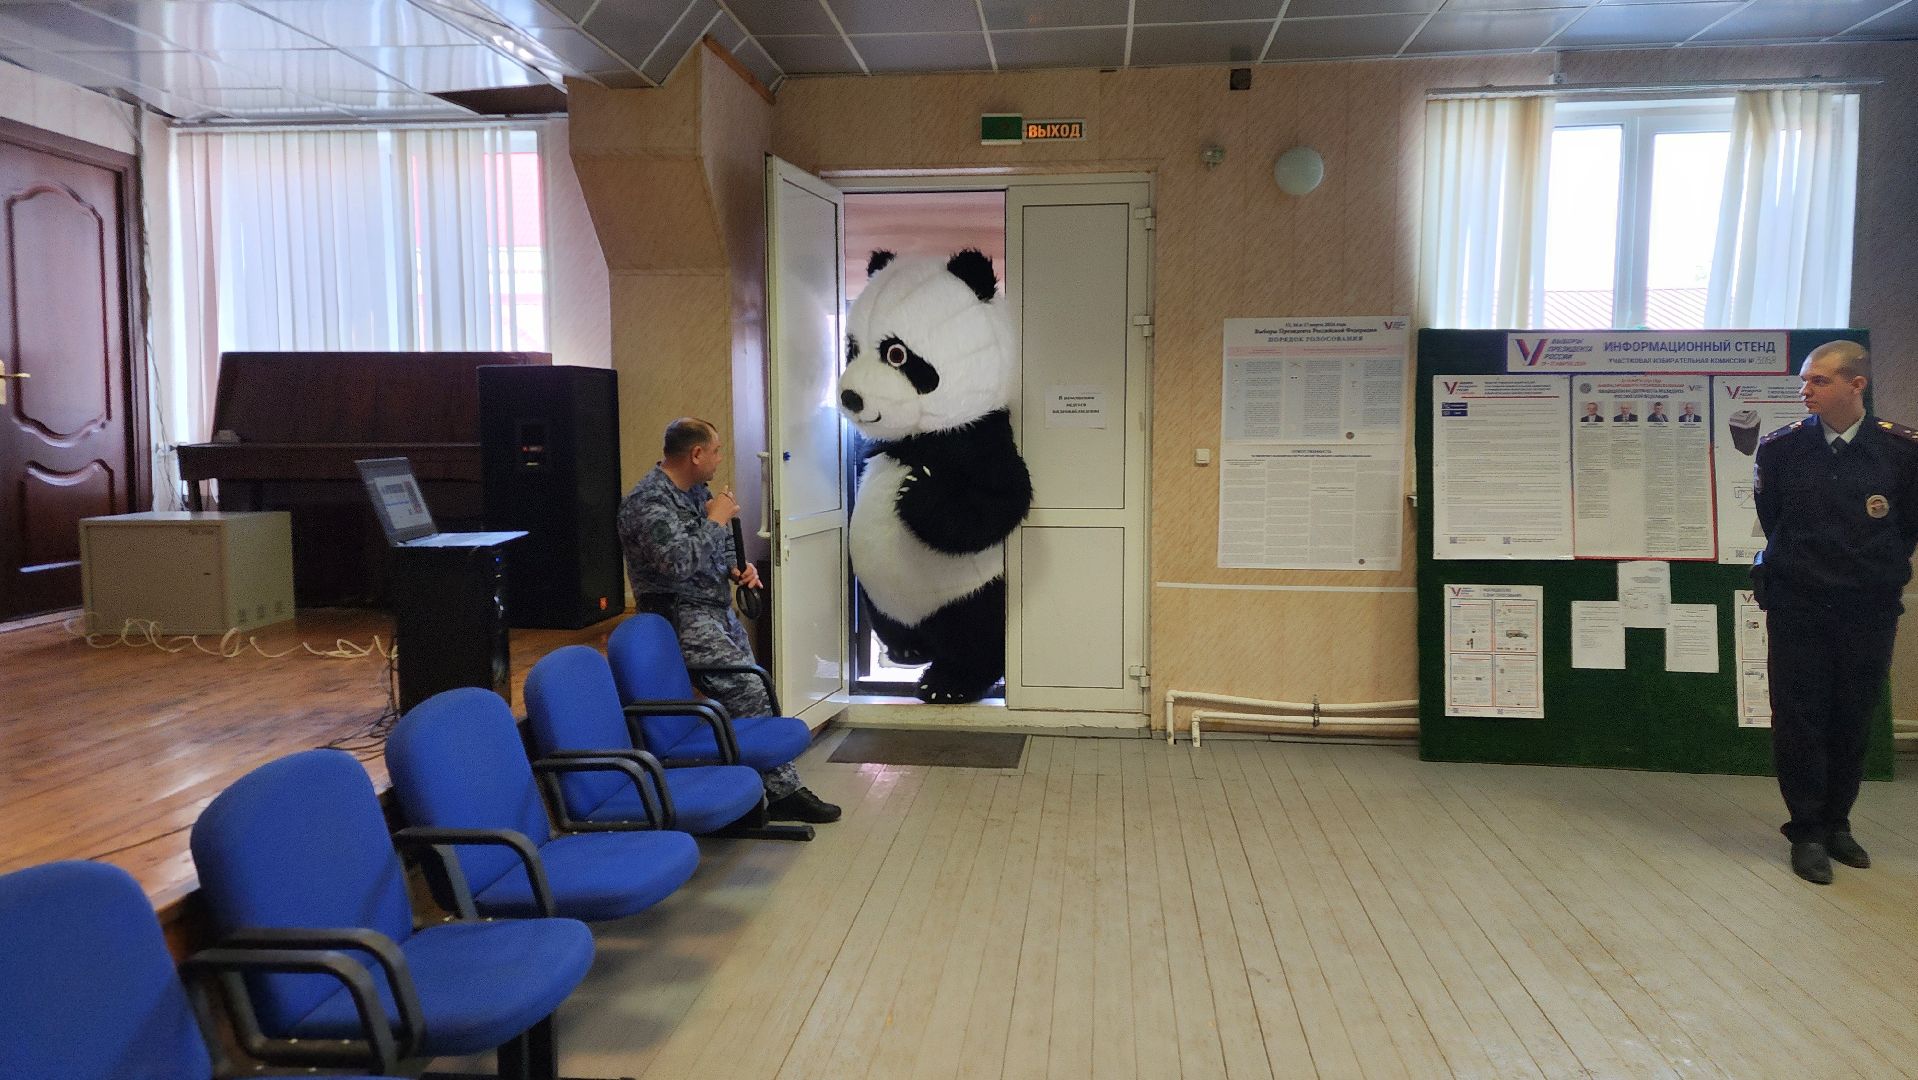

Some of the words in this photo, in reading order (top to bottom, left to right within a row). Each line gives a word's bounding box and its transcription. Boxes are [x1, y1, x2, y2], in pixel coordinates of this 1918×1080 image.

[1027, 123, 1081, 139] ВЫХОД
[1603, 339, 1731, 354] ИНФОРМАЦИОННЫЙ
[1734, 340, 1777, 354] СТЕНД
